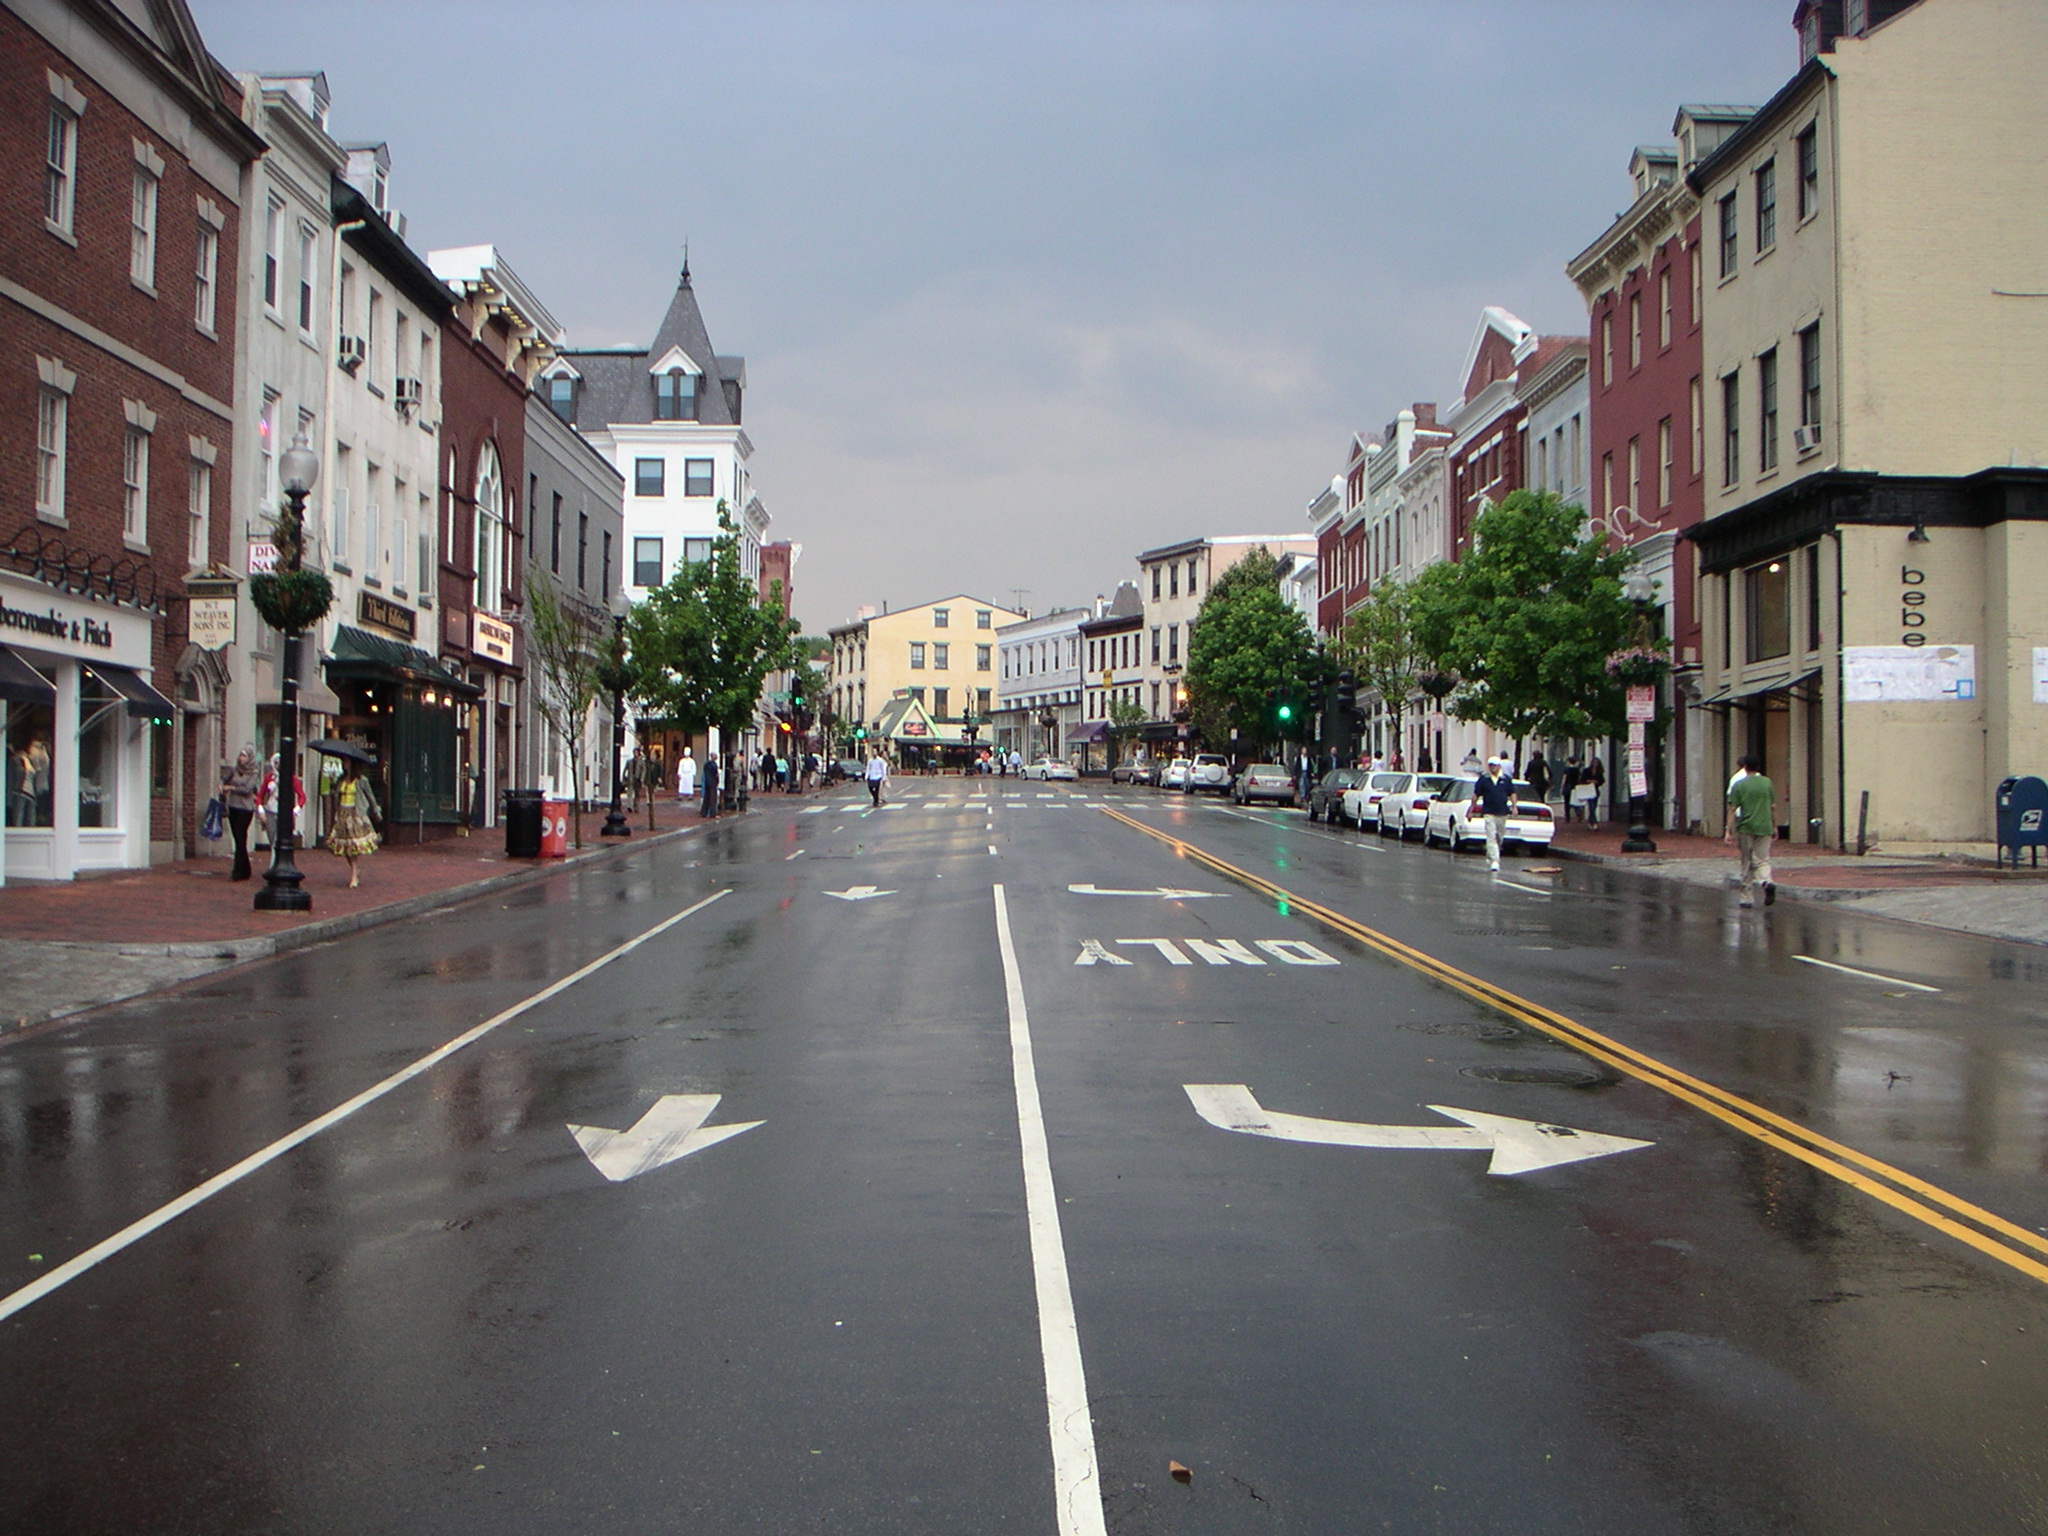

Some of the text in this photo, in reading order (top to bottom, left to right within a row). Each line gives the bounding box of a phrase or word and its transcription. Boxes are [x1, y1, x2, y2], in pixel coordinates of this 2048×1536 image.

[367, 597, 411, 632] Third Edition
[1902, 565, 1926, 647] bebe
[71, 620, 81, 641] &
[84, 616, 112, 648] Fitch
[1074, 938, 1341, 966] ONLY
